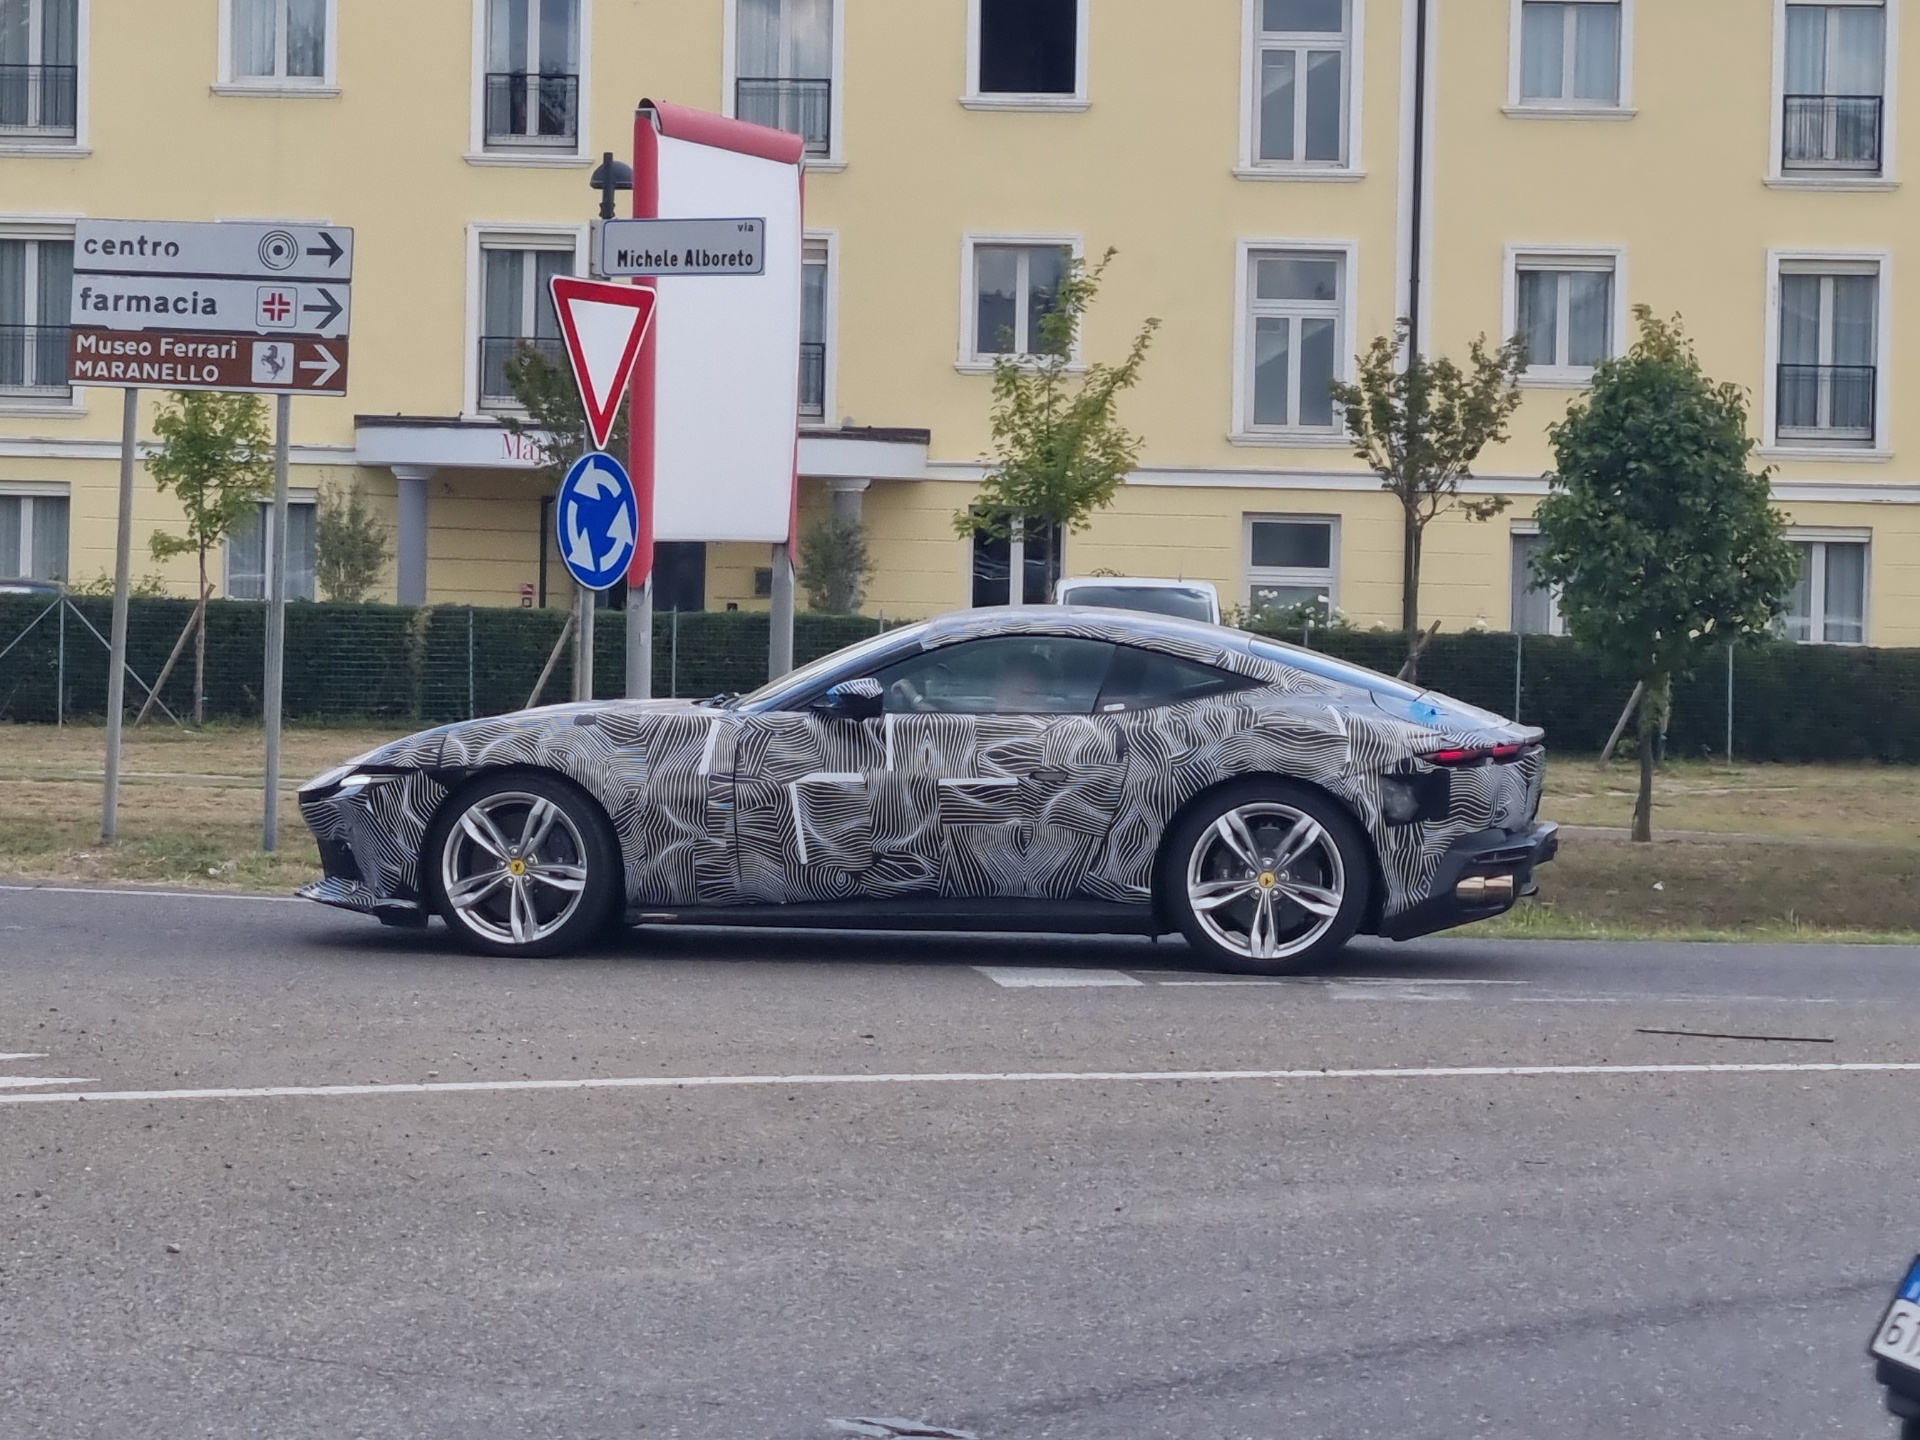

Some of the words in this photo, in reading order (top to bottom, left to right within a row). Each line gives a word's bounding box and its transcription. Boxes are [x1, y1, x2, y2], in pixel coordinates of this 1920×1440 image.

[737, 222, 754, 232] via
[83, 235, 180, 257] centro
[617, 249, 678, 267] Michele
[684, 249, 753, 267] Alboreto
[79, 287, 217, 315] farmacia
[76, 335, 151, 356] Museo
[160, 338, 237, 359] Ferrari
[75, 361, 219, 382] MARANELLO
